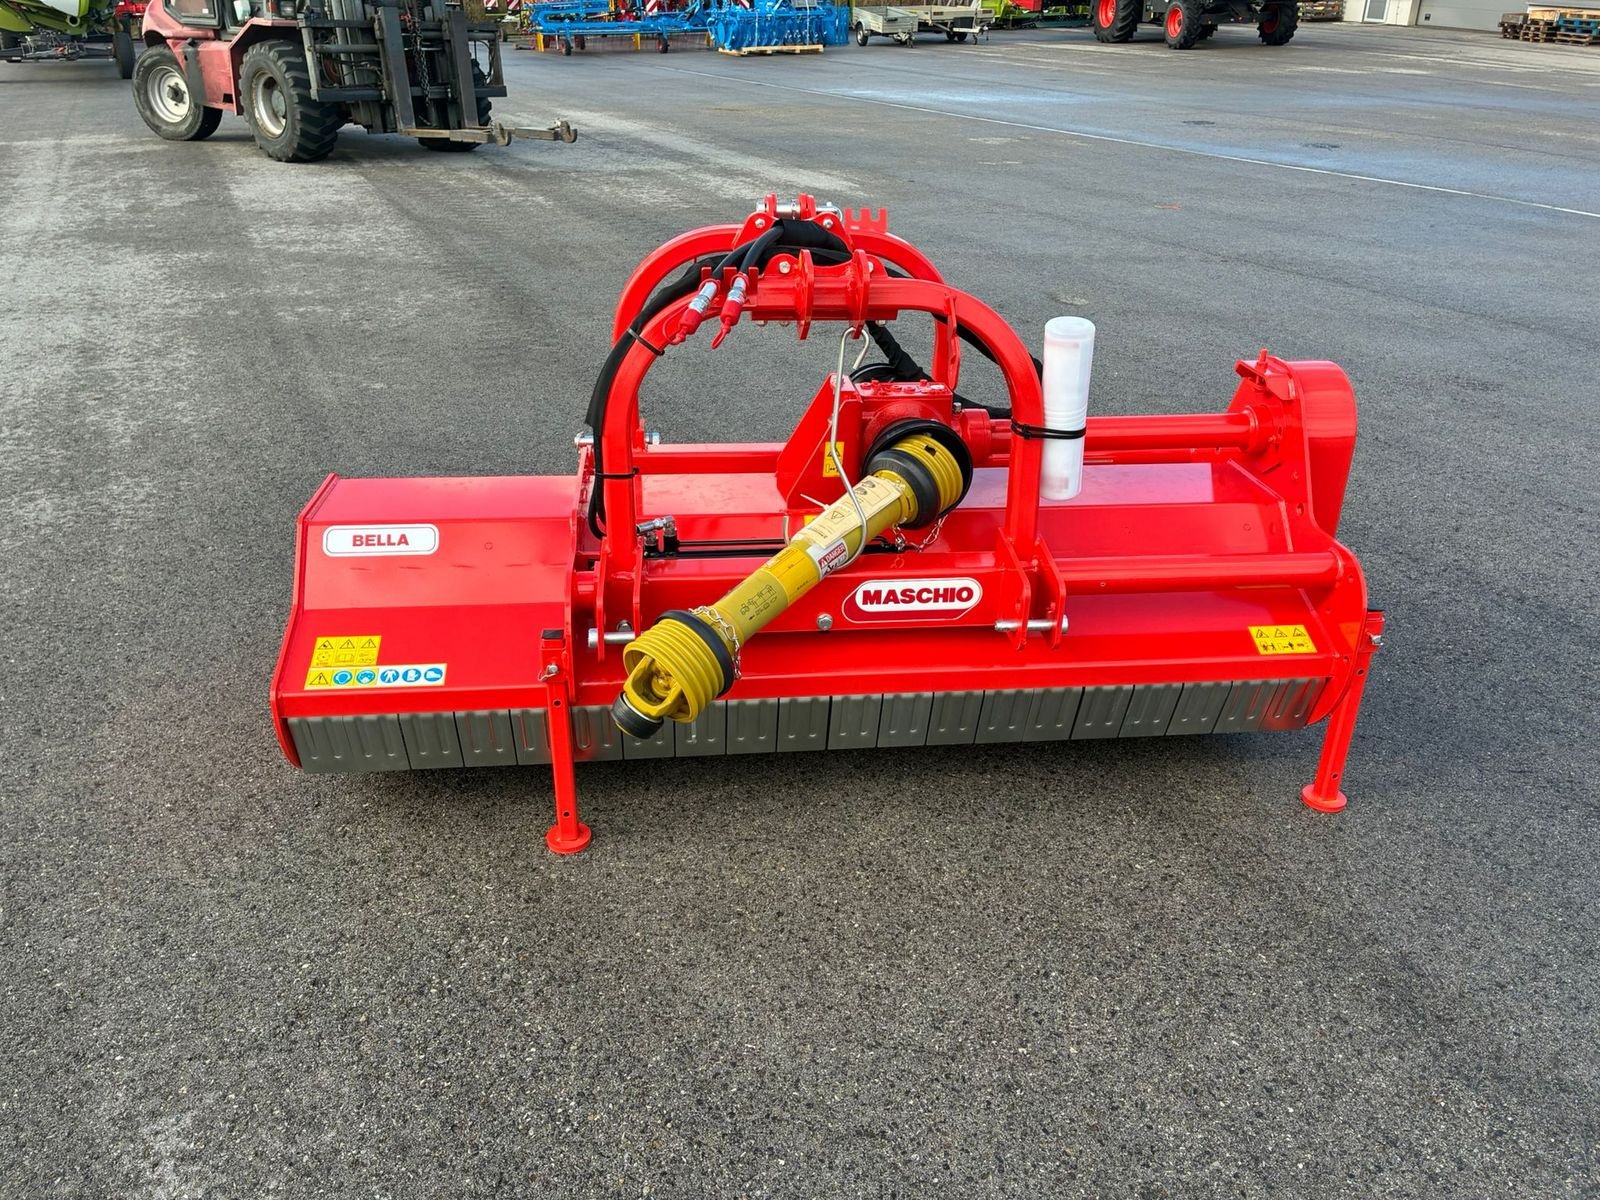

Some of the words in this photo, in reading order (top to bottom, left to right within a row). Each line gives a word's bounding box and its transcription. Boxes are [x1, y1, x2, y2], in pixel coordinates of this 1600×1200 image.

[352, 534, 409, 547] BELLA
[825, 545, 846, 562] DANGER
[862, 586, 974, 605] MASCHIO
